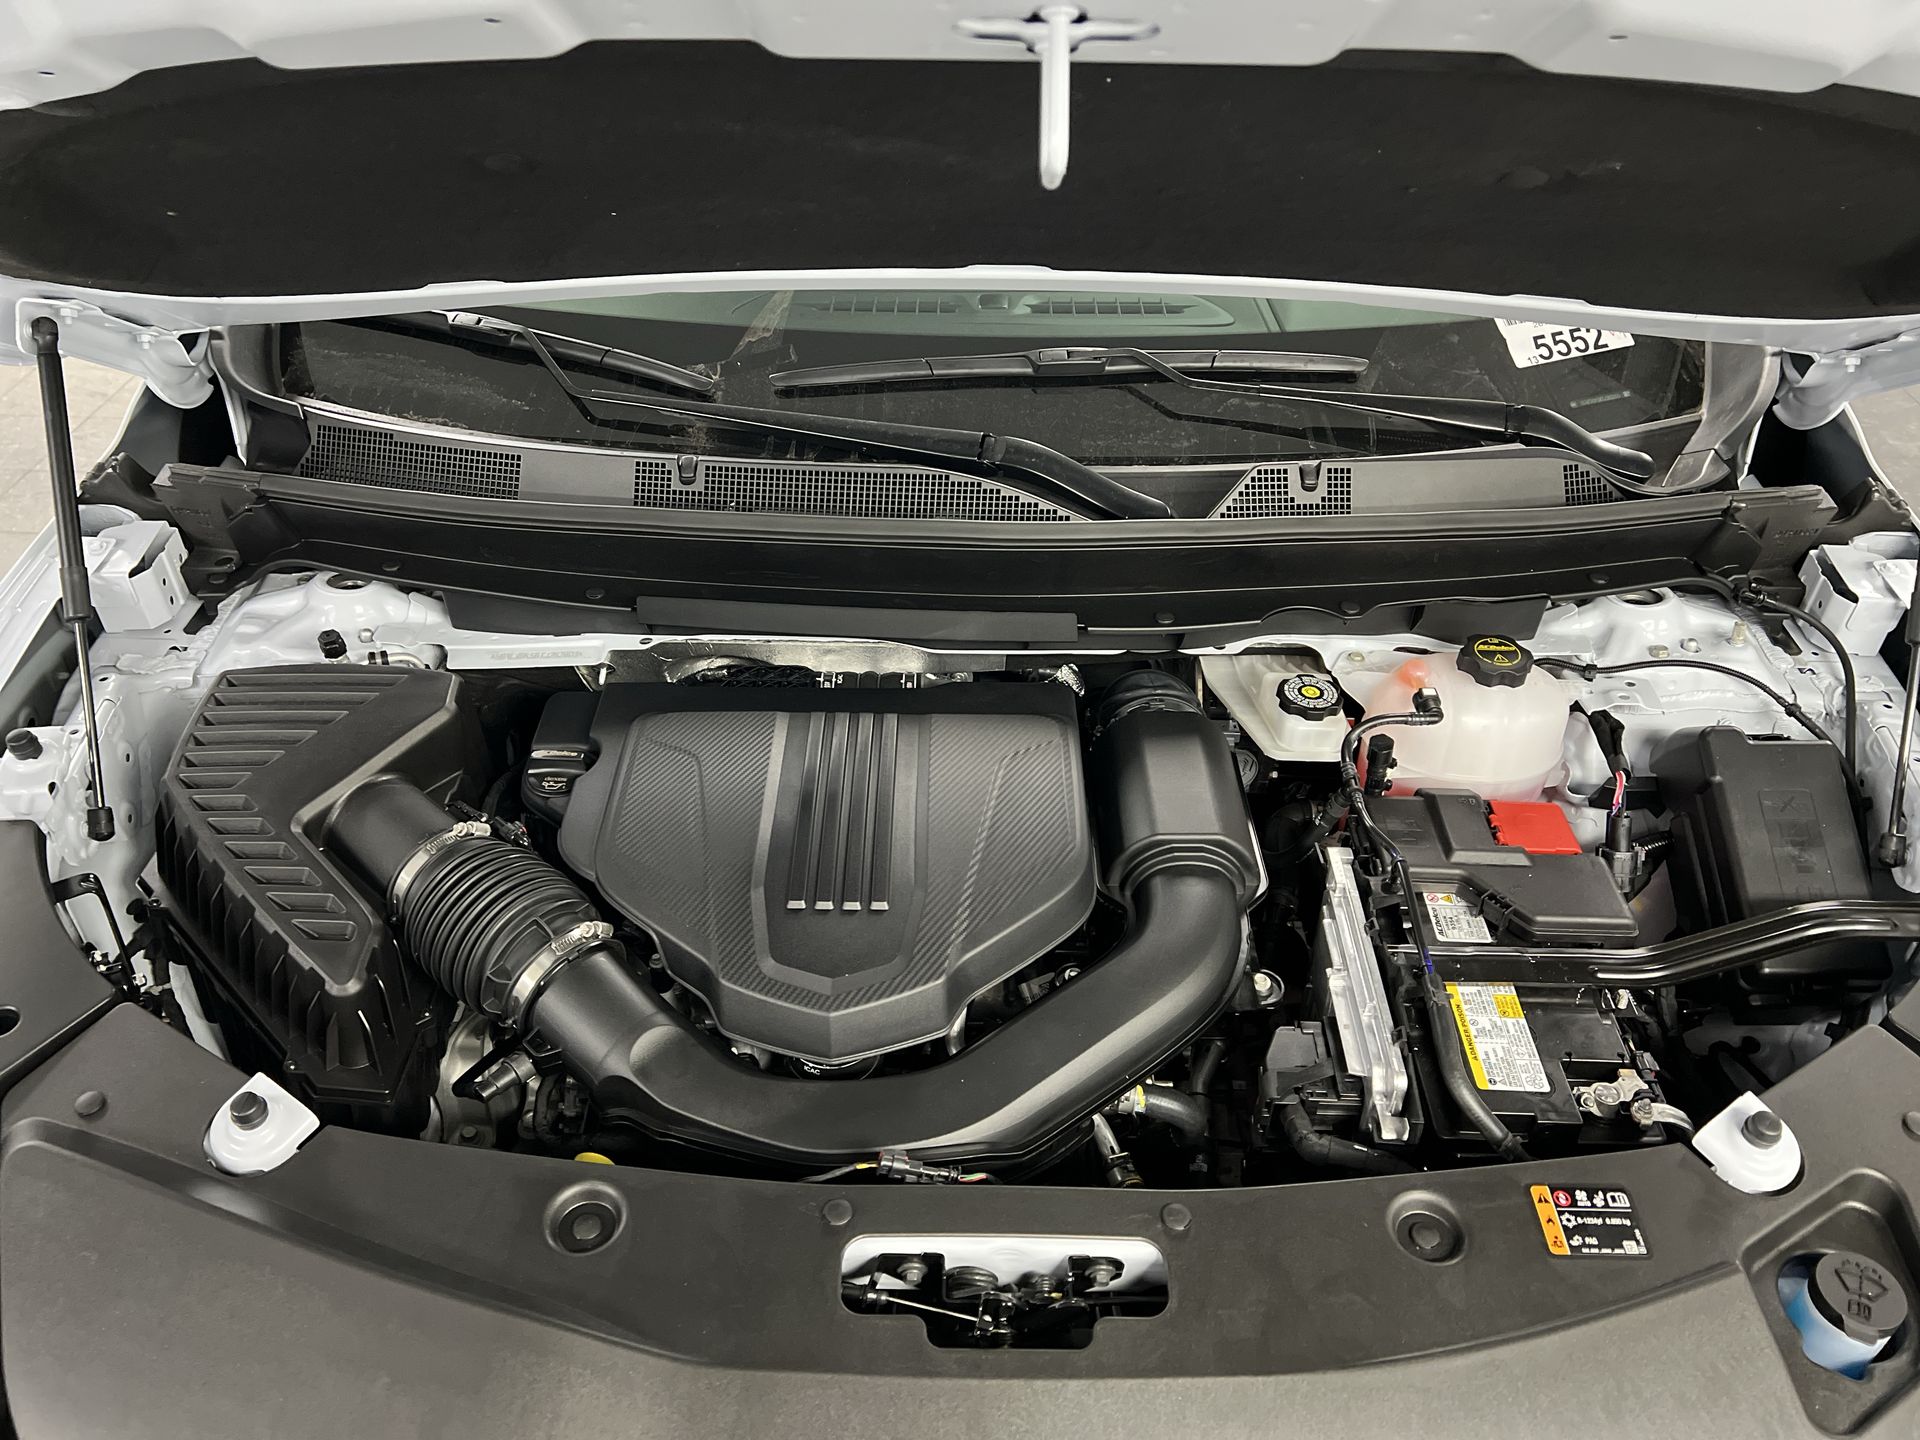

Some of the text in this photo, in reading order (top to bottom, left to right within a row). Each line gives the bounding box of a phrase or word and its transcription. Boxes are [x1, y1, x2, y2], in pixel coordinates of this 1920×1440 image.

[1532, 327, 1609, 361] 5552
[1527, 355, 1540, 365] 13
[1431, 907, 1445, 937] ACDelco
